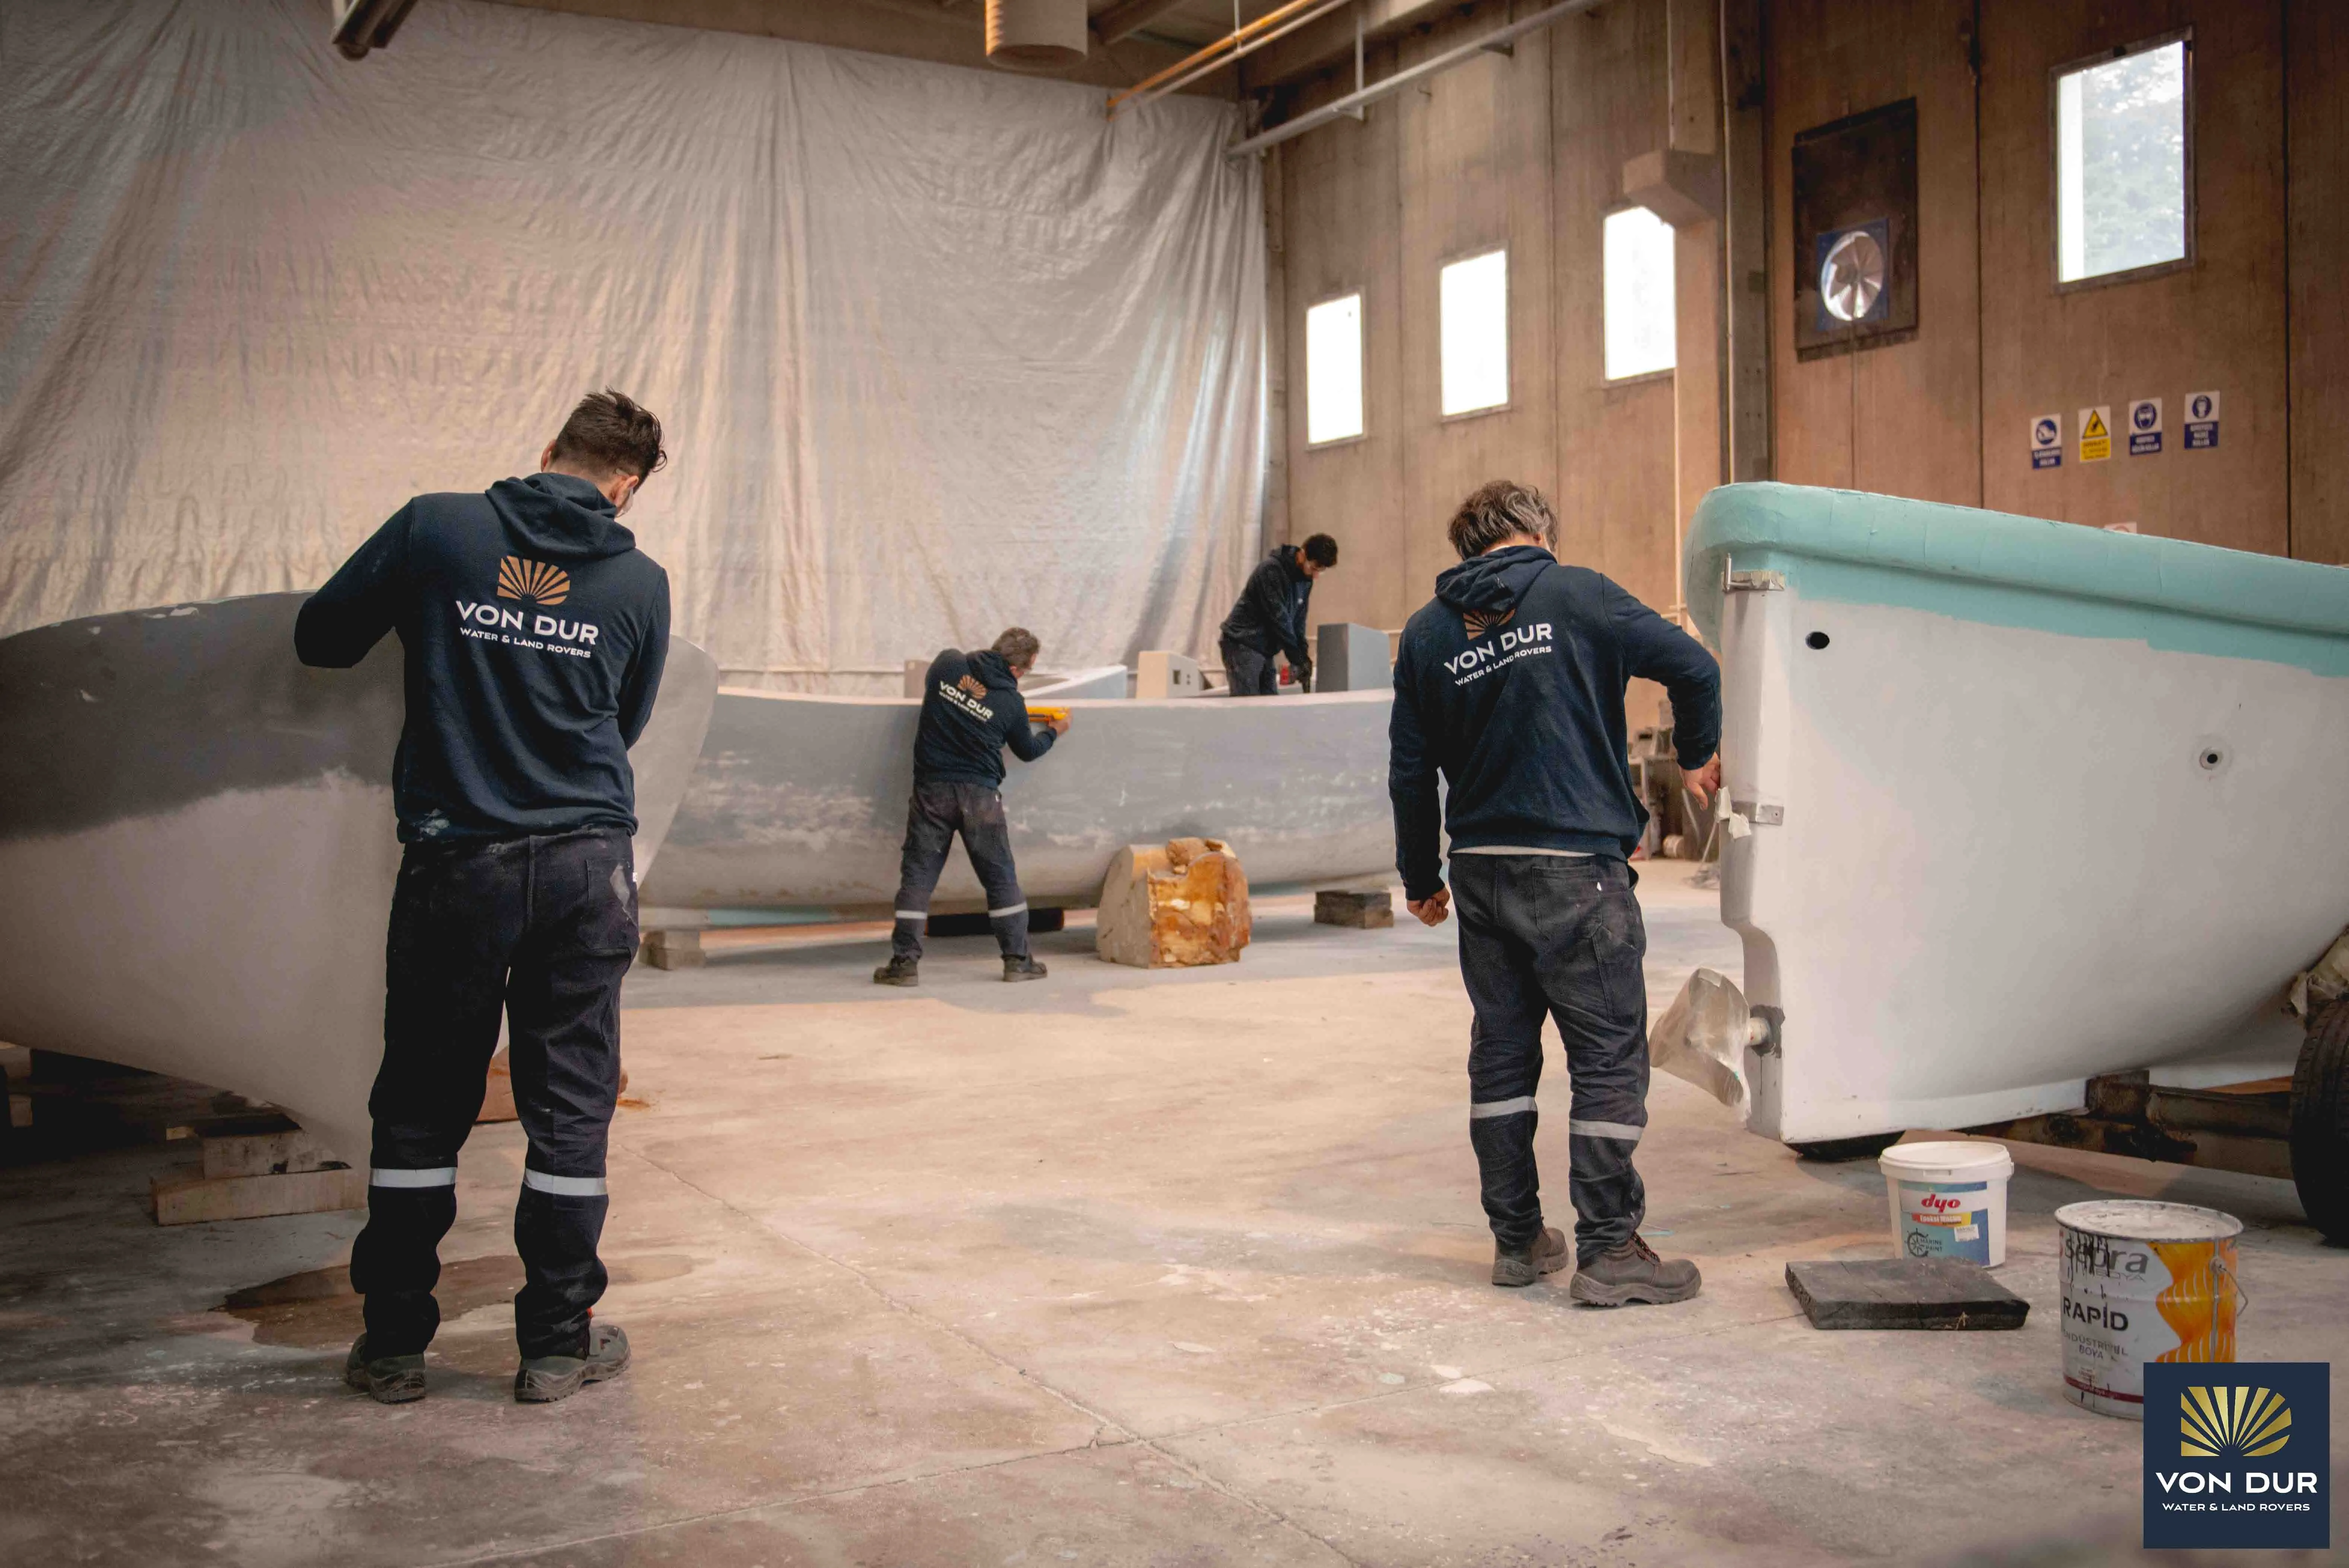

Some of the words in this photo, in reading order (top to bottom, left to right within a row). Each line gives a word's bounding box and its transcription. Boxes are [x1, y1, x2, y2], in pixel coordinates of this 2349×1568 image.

[456, 601, 523, 630] VON
[534, 615, 599, 645] DUR
[460, 627, 498, 641] WATER
[502, 635, 510, 643] &
[514, 637, 544, 650] LAND
[547, 644, 591, 659] ROVERS
[1444, 641, 1495, 675] VON
[1500, 623, 1553, 651] DUR
[1455, 669, 1484, 687] WATER
[1493, 655, 1515, 669] LAND
[1514, 645, 1552, 658] ROVERS
[940, 680, 966, 702] VON
[967, 698, 994, 719] DUR
[1921, 1193, 1961, 1213] dyo
